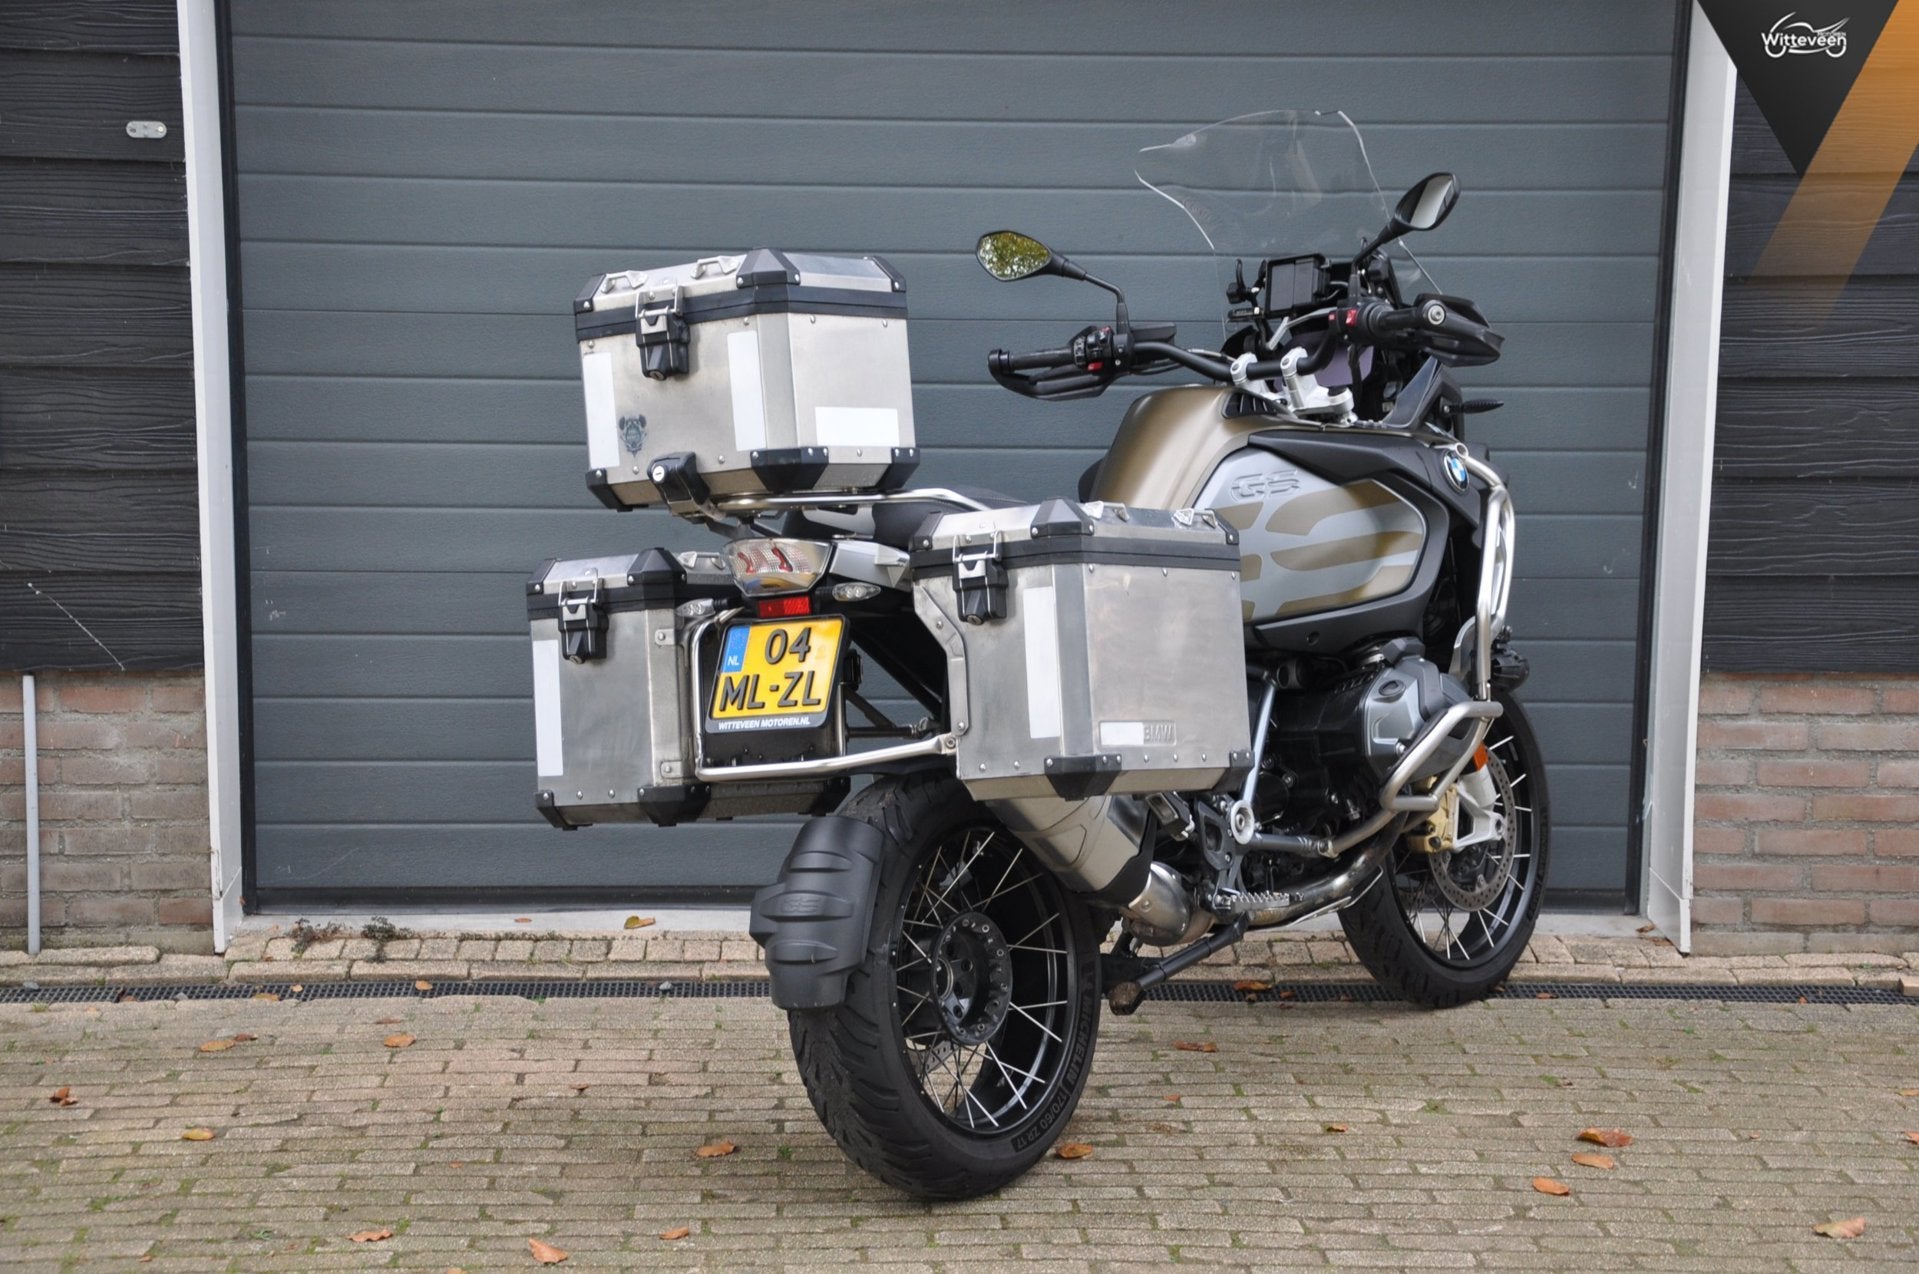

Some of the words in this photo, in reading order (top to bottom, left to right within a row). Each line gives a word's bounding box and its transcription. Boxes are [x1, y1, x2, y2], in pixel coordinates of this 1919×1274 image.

[1231, 469, 1299, 500] GS
[727, 655, 739, 666] NL
[765, 626, 812, 665] 04
[719, 670, 822, 711] ML-ZL
[718, 720, 760, 730] WITTEVEEN
[761, 716, 811, 728] MOTOREN.NL
[1066, 996, 1094, 1085] MICHELIN
[1040, 1088, 1068, 1130] 170/60
